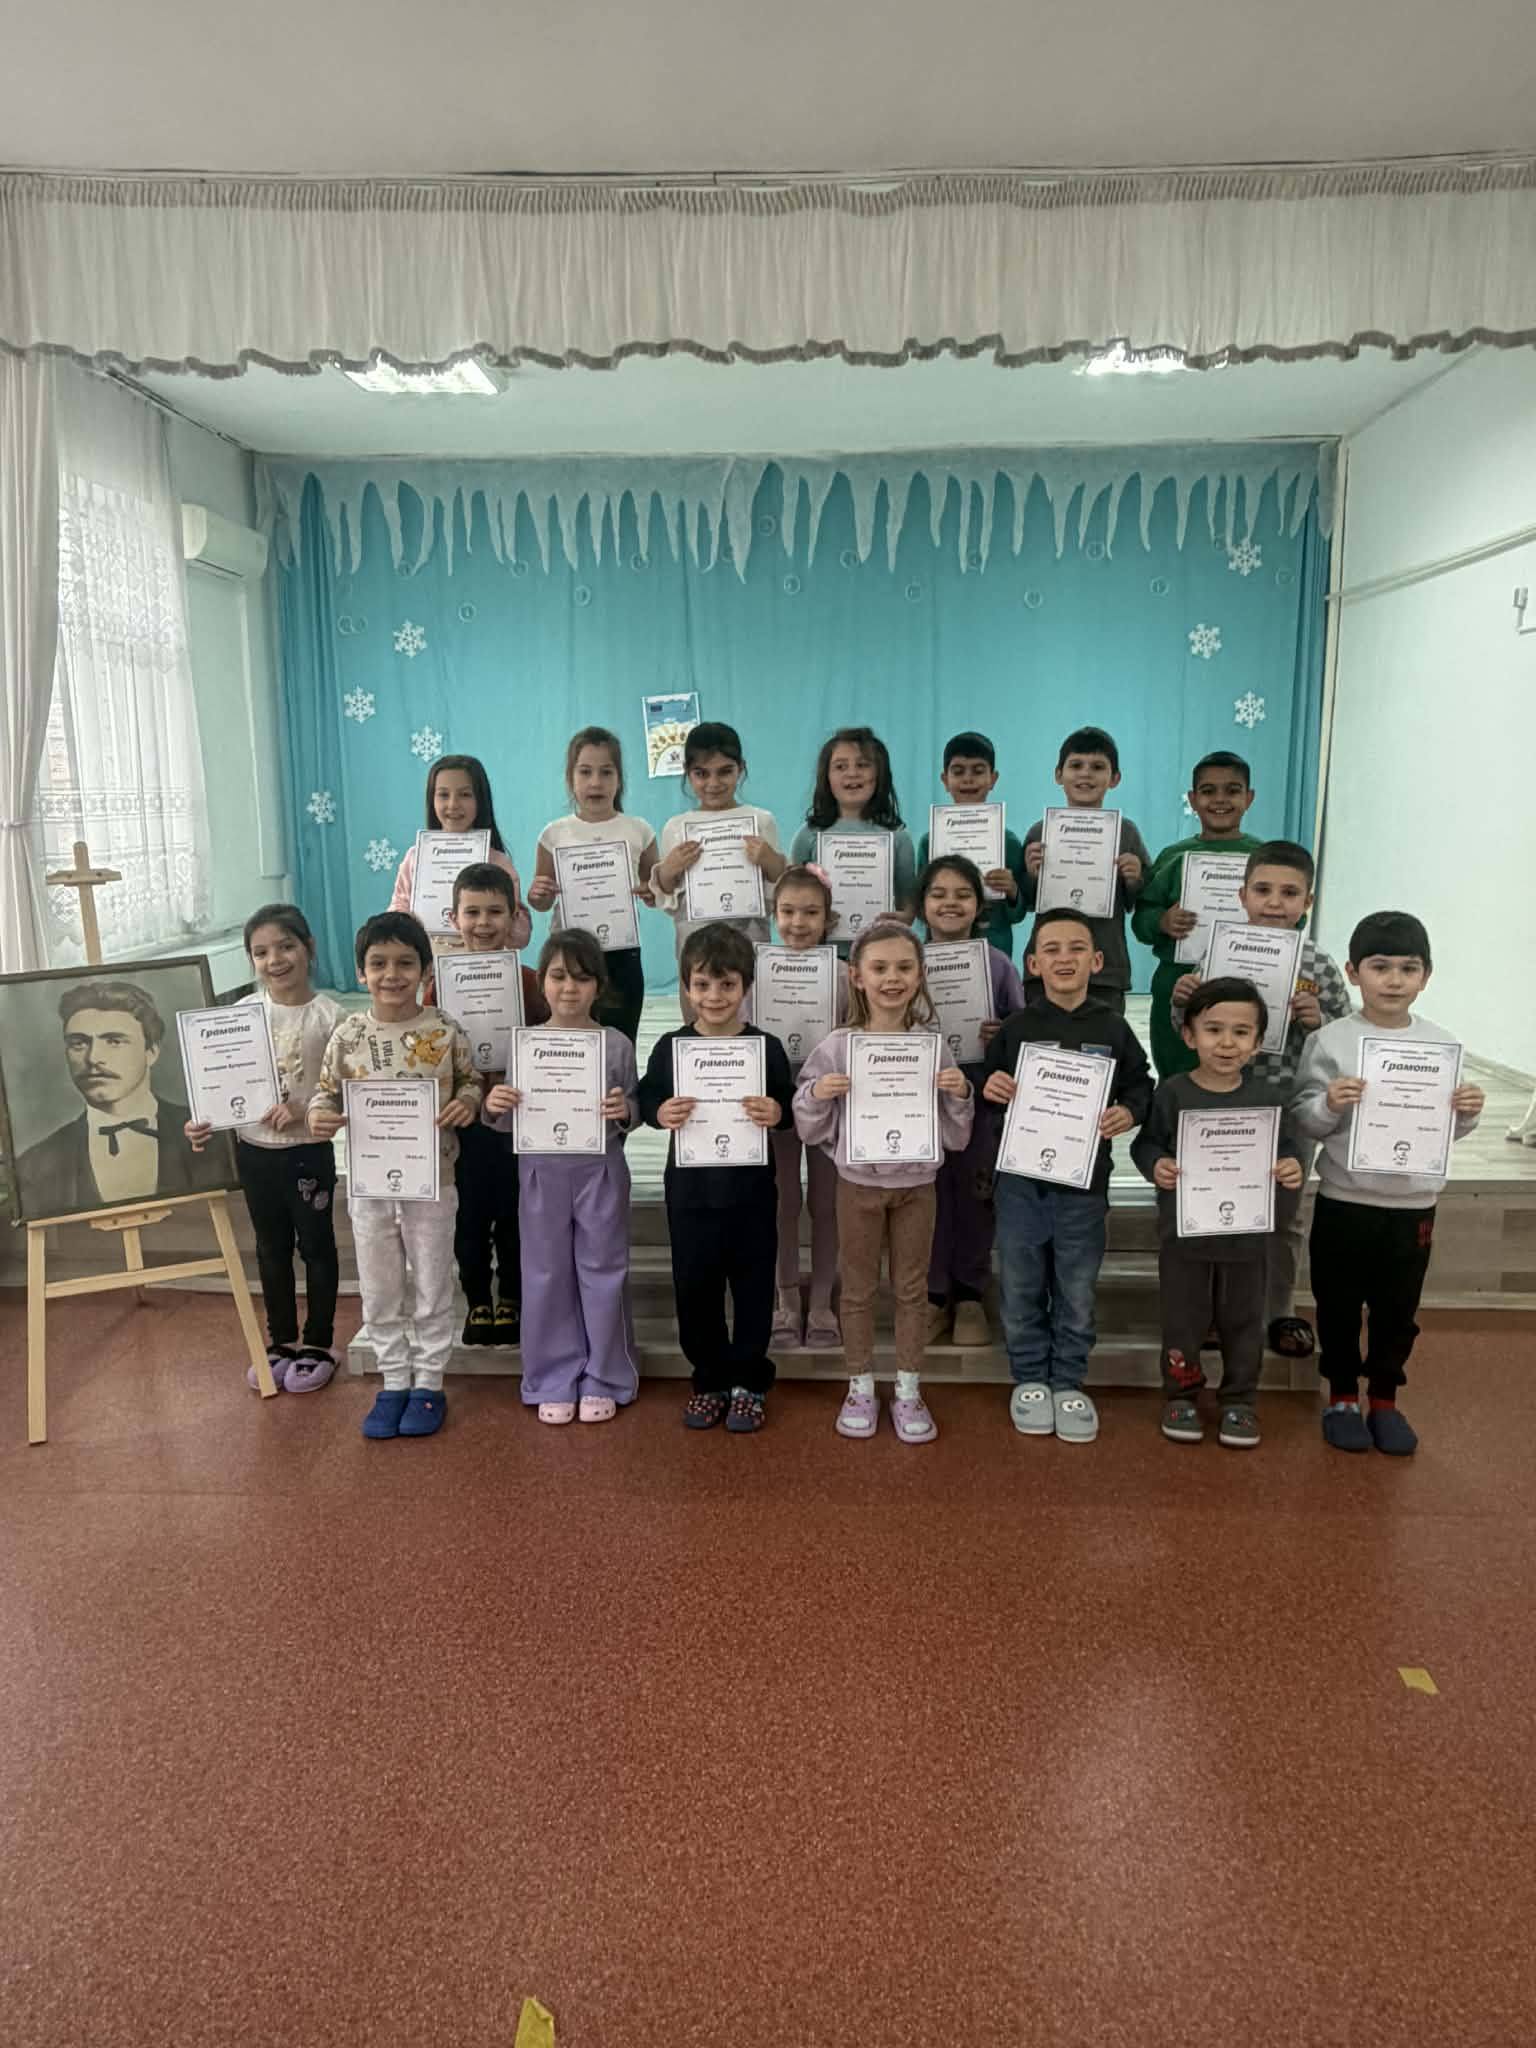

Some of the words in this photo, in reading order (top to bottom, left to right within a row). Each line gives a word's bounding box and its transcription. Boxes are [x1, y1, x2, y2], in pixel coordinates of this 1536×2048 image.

[571, 860, 615, 872] Грамота
[1228, 940, 1281, 956] Грамота
[770, 961, 819, 974] Грамота
[455, 970, 503, 984] Грамота
[200, 1023, 252, 1039] Грамота
[533, 1047, 586, 1060] Грамота
[867, 1053, 920, 1065] Грамота
[694, 1057, 746, 1070] Грамота
[1381, 1059, 1441, 1074] Грамота
[1036, 1066, 1091, 1087] Грамота
[365, 1096, 419, 1109] Грамота
[1199, 1126, 1257, 1140] Грамота
